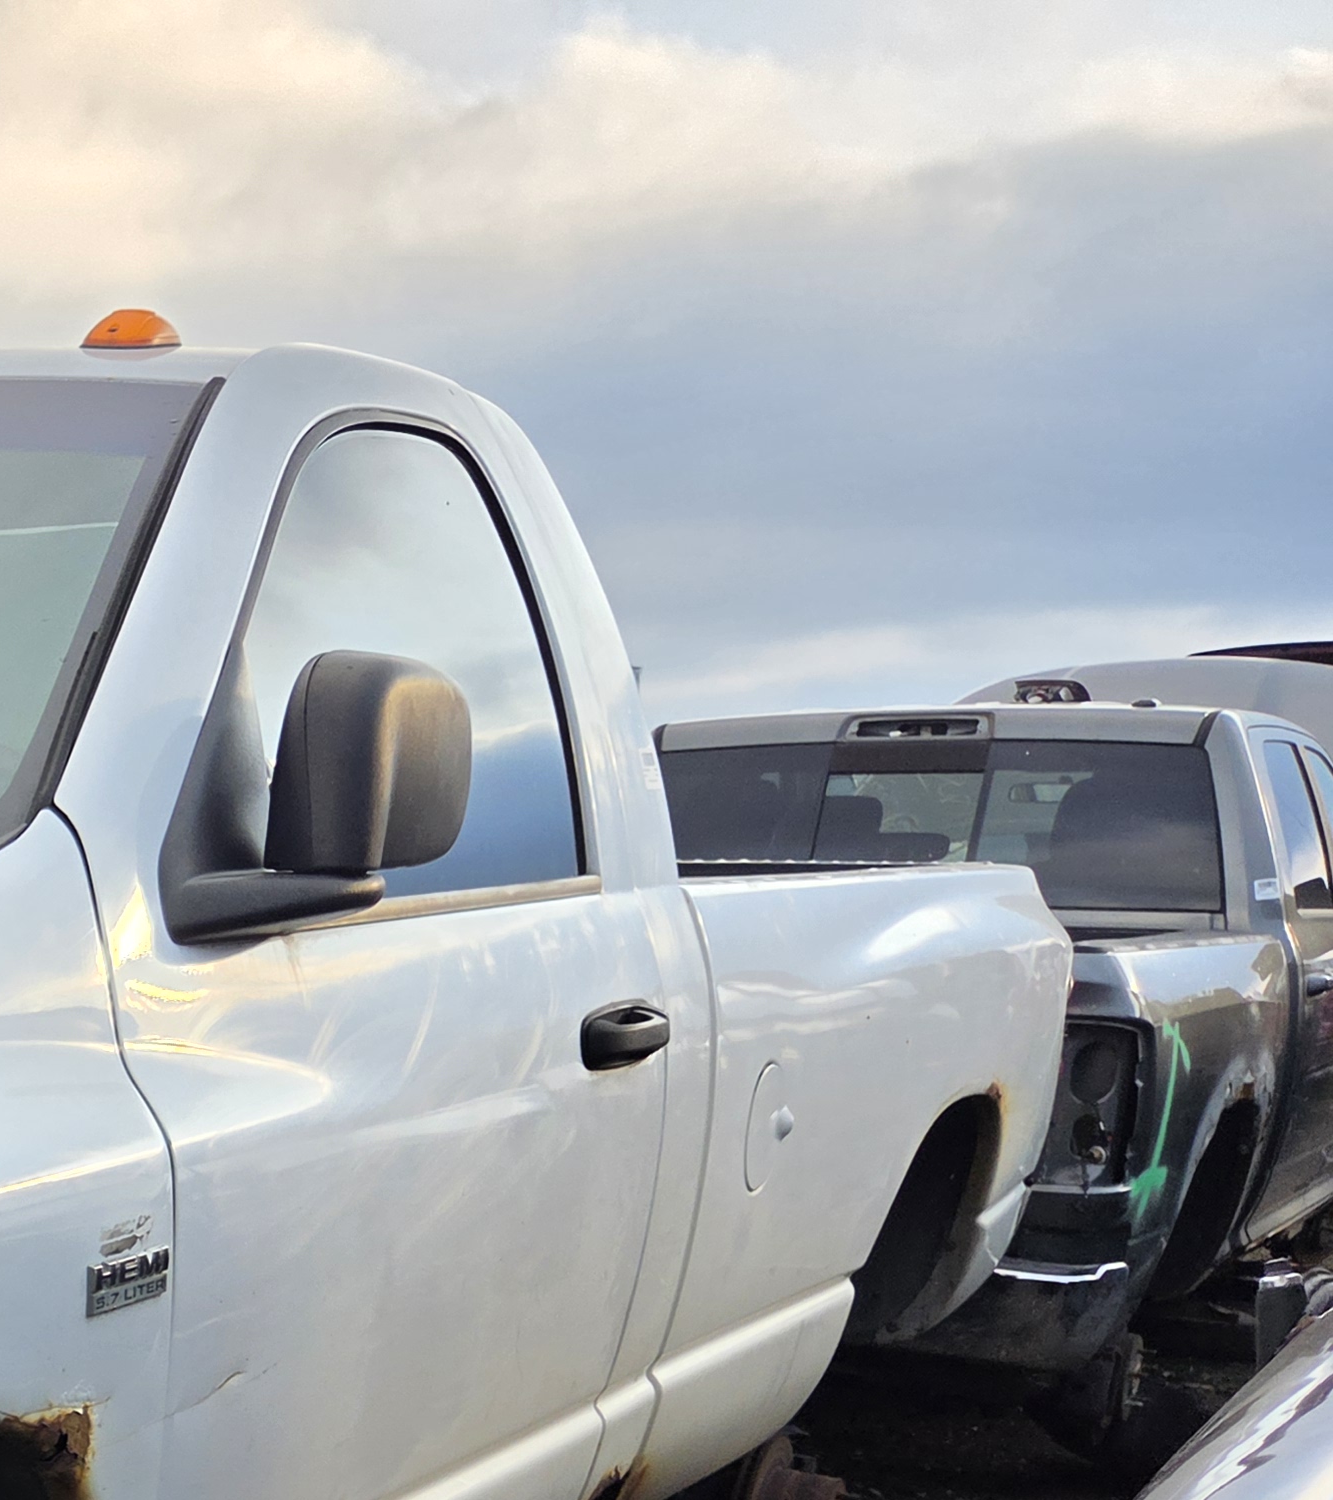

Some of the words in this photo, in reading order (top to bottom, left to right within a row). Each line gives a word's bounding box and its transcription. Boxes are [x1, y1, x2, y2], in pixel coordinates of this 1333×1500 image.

[92, 1245, 170, 1295] HEMI
[95, 1292, 120, 1310] 5.7
[123, 1280, 165, 1301] LITER
